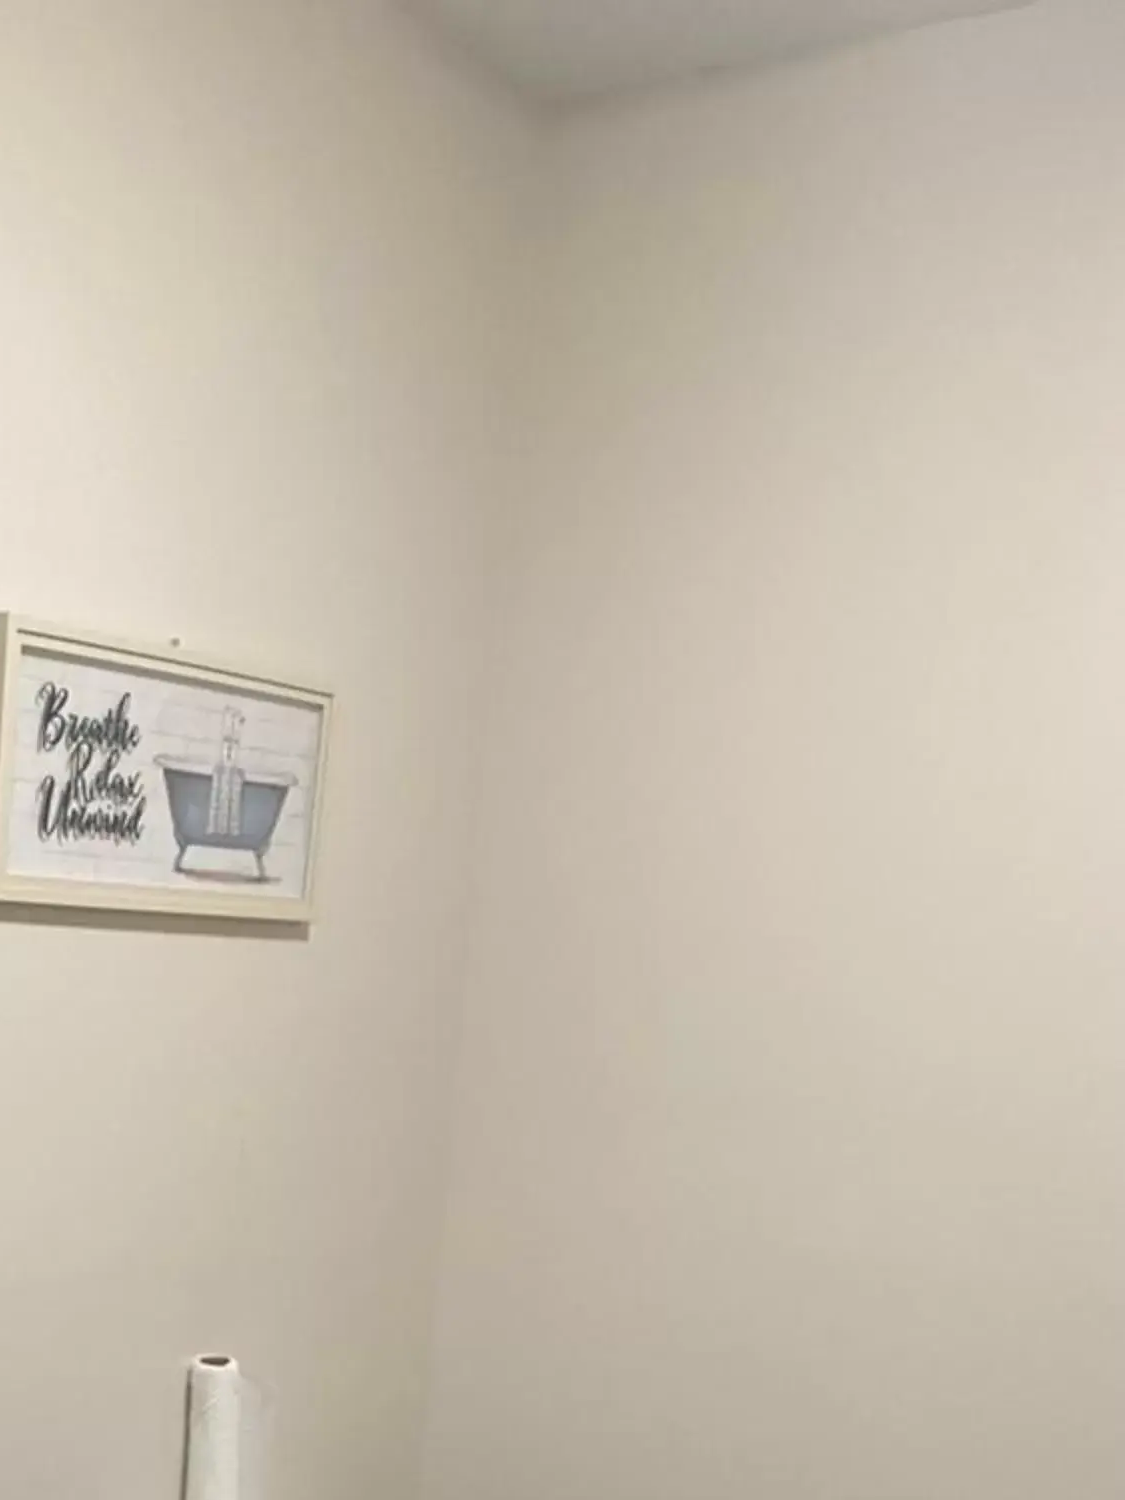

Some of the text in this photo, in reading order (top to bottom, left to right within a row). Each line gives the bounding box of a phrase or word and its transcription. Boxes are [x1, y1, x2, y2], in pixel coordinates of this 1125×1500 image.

[35, 681, 141, 754] Breathe
[66, 740, 143, 804] Relax
[35, 775, 146, 846] Unwind
